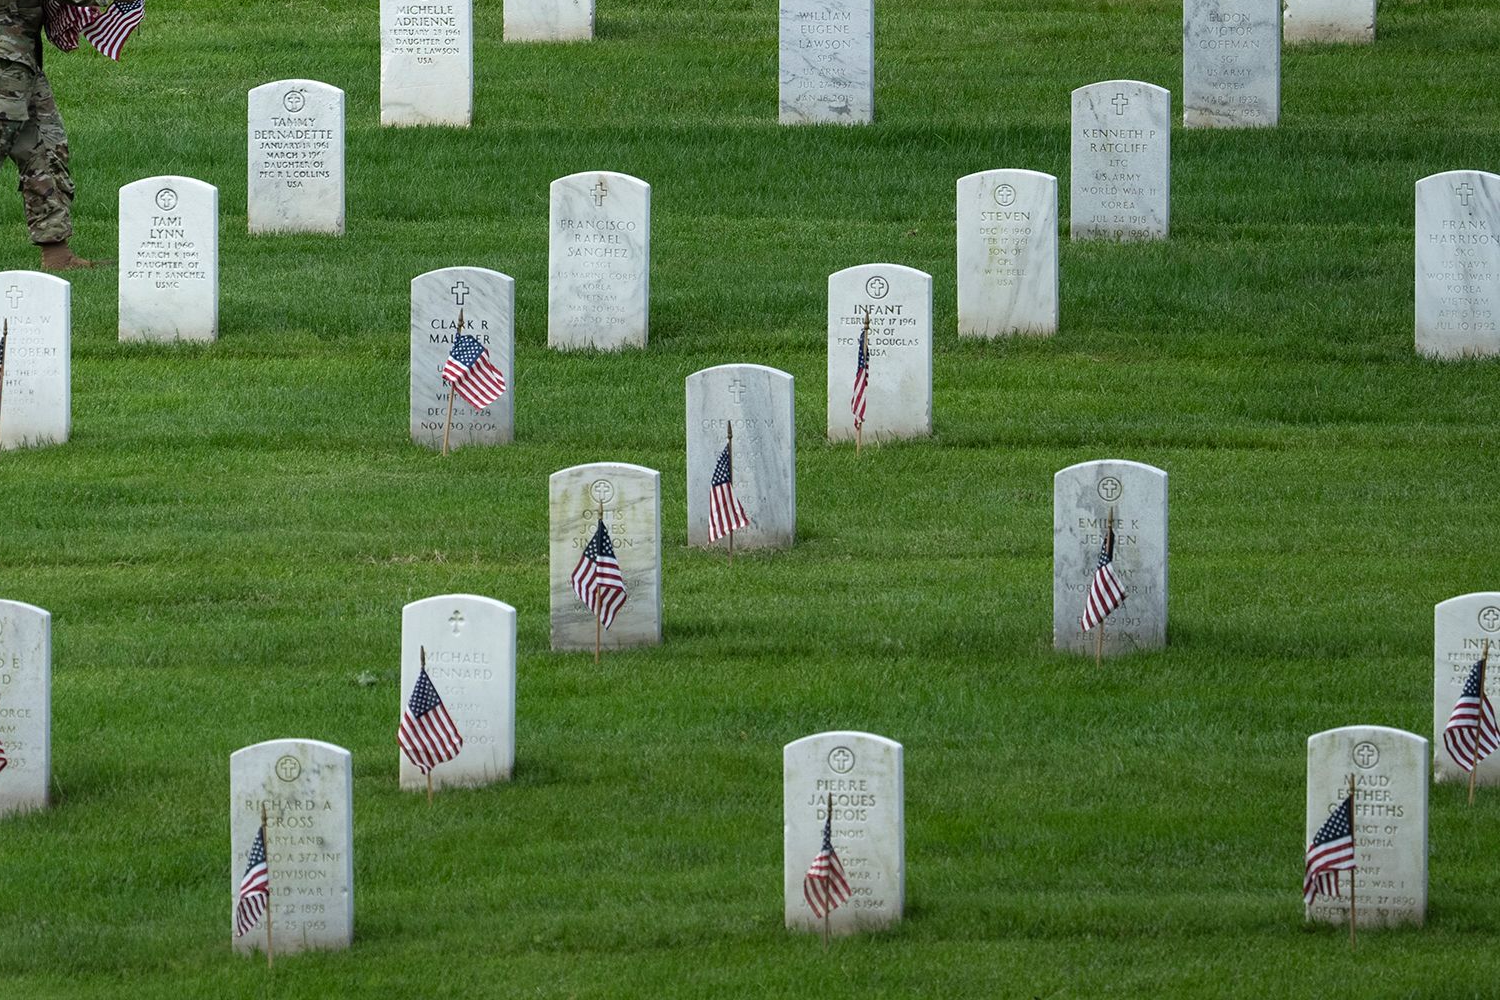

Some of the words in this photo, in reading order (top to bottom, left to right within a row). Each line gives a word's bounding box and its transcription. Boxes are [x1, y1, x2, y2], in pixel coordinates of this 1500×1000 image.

[397, 5, 453, 15] MICHELLE
[798, 10, 851, 21] WILLIAM
[397, 17, 455, 27] ADRIENNE
[800, 24, 849, 34] EUGENE
[799, 39, 851, 49] LAWSON
[271, 117, 316, 127] TAMMY
[254, 129, 332, 140] BERNADETTE
[1083, 129, 1143, 138] KENNETH
[1149, 129, 1155, 138] P
[1090, 143, 1147, 153] RATCLIFF
[153, 216, 182, 226] TAMI
[981, 211, 1031, 221] STEVEN
[560, 219, 636, 230] FRANCISCO
[1442, 220, 1487, 229] FRANK
[150, 229, 184, 239] LYNN
[574, 233, 620, 243] RAFAEL
[567, 247, 628, 258] SANCHEZ
[155, 281, 179, 289] USMC
[853, 305, 903, 316] INFANT
[12, 657, 21, 669] E
[816, 779, 868, 791] PIERRE
[245, 799, 316, 811] RICHARD
[323, 800, 332, 811] A
[807, 794, 877, 807] JACQUES
[816, 809, 868, 821] DBOIS
[265, 815, 314, 829] GROSS
